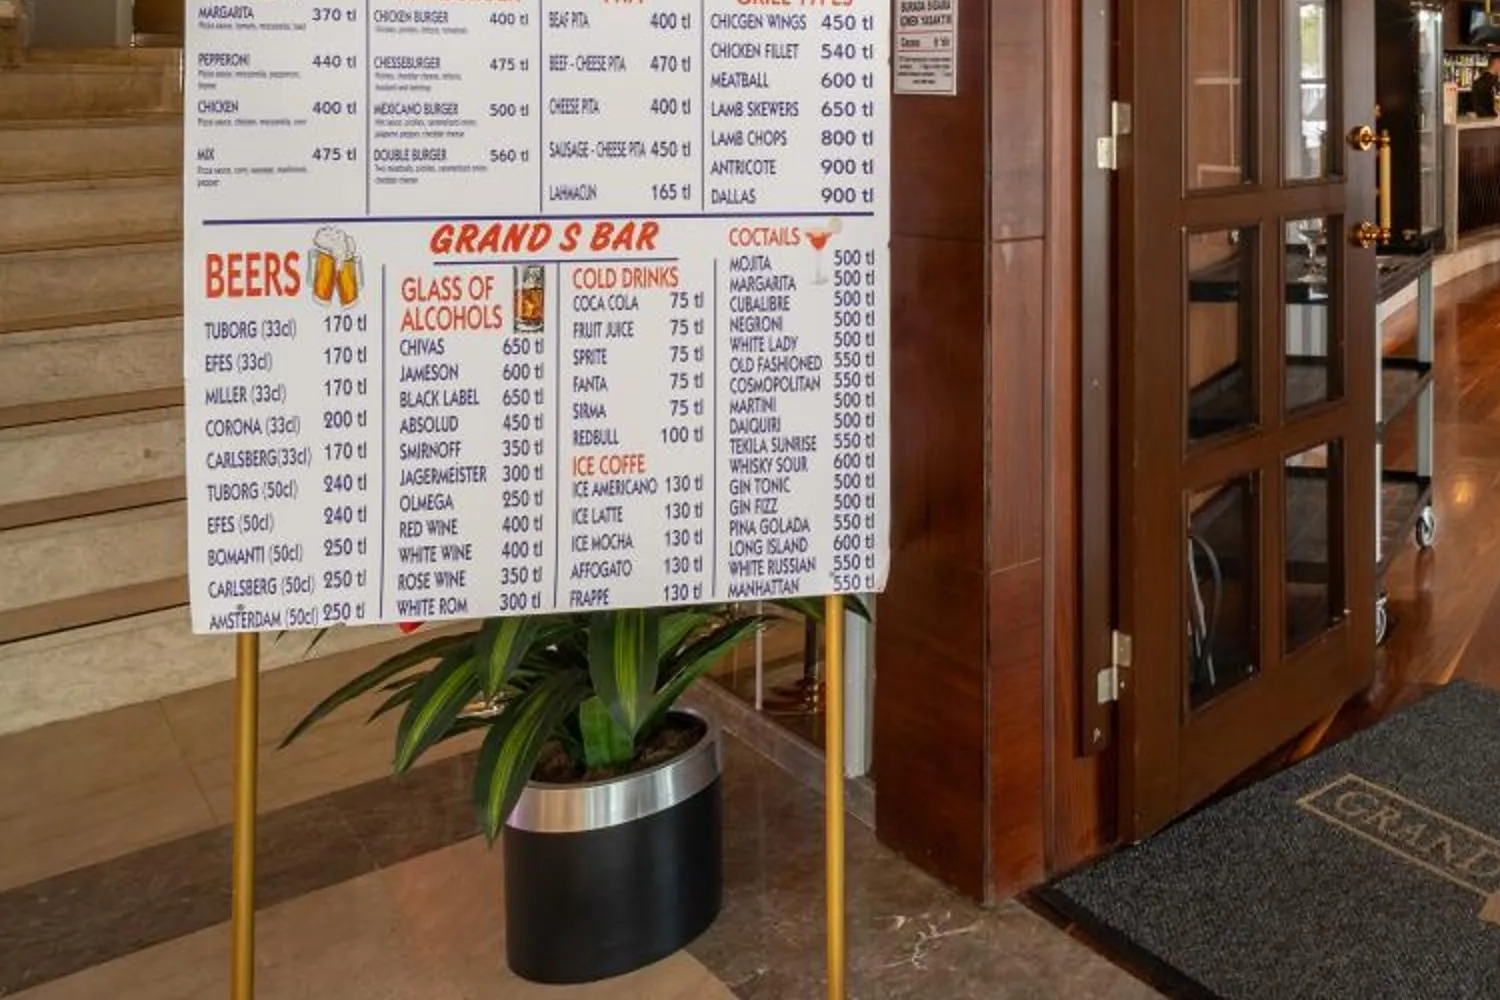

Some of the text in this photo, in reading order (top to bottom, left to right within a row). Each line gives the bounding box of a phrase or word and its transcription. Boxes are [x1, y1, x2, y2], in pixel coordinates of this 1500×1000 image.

[198, 6, 356, 21] MARGARITA 370 tl
[411, 10, 448, 23] BURGER
[490, 13, 515, 25] 400
[520, 13, 528, 25] tl
[650, 13, 677, 29] 400
[710, 13, 856, 30] CHICGEN WINGS 450
[710, 42, 856, 59] CHICKEN FILLET 540
[198, 53, 356, 68] PEPPERONI 440 tl
[490, 58, 515, 71] 475
[650, 56, 678, 72] 470
[710, 72, 856, 88] MEATBALL 600
[198, 100, 356, 114] CHICKEN 400 tl
[421, 103, 458, 115] BURGER
[489, 104, 516, 117] 500
[650, 98, 677, 115] 400
[711, 101, 856, 117] LAMB SKEWERS 650
[711, 130, 856, 146] LAMB CHOPS 800
[197, 148, 356, 161] MIX 475 tl
[374, 148, 516, 162] DOUBLE BURGER 560
[710, 159, 856, 175] ANTRICOTE 900
[652, 184, 677, 200] 165
[711, 187, 856, 204] DALLAS 900
[430, 222, 659, 254] GRAND S BAR
[729, 227, 801, 246] COCTAILS
[730, 255, 772, 272] MOJITA
[206, 252, 300, 298] BEERS
[573, 267, 678, 290] COLD DRINKS
[730, 275, 796, 292] MARGARITA
[402, 276, 494, 302] GLASS OF
[573, 294, 639, 312] COCA COLA
[730, 296, 790, 312] CUBALIBRE
[400, 305, 502, 331] ALCOHOLS
[730, 316, 783, 333] NEGRONI
[204, 321, 257, 339] TUBORG
[573, 321, 634, 338] FRUIT JUICE
[400, 338, 444, 356] CHIVAS
[730, 336, 798, 352] WHITE LADY
[205, 354, 233, 372] EFES
[573, 348, 607, 365] SPRITE
[730, 355, 822, 374] OLD FASHIONED
[400, 364, 458, 382] JAMESON
[573, 376, 608, 392] FANTA
[730, 376, 820, 394] COSMOPOLITAN
[205, 386, 247, 404] MILLER
[400, 389, 480, 408] BLACK LABEL
[573, 403, 606, 420] SIRMA
[730, 397, 776, 414] MARTINI
[206, 418, 262, 437] CORONA
[400, 416, 458, 434] ABSOLUD
[730, 417, 780, 434] DAIQUIRI
[573, 429, 619, 446] REDBULL
[730, 435, 816, 454] TEKILA SUNRISE
[400, 441, 461, 460] SMIRNOFF
[573, 454, 646, 476] ICE COFFE
[730, 456, 808, 474] WHISKY SOUR
[207, 482, 259, 501] TUBORG
[573, 478, 658, 498] ICE AMERICANO
[729, 476, 790, 495] GIN TONIC
[400, 493, 454, 512] OLMEGA
[730, 498, 778, 516] GIN FIZZ
[572, 506, 623, 525] ICE LATTE
[208, 516, 235, 534] EFES
[400, 518, 458, 538] RED WINE
[572, 533, 634, 552] ICE MOCHA
[729, 537, 808, 557] LONG ISLAND
[208, 546, 264, 566] BOMANTI
[399, 544, 472, 563] WHITE WINE
[570, 560, 632, 579] AFFOGATO
[728, 557, 816, 576] WHITE RUSSIAN
[208, 578, 277, 598] CARLSBERG
[398, 570, 466, 590] ROSE WINE
[728, 580, 799, 597] MANHATTAN
[570, 588, 609, 606] FRAPPE
[397, 597, 468, 616] WHITE ROM
[209, 610, 281, 630] AMSTERDAM
